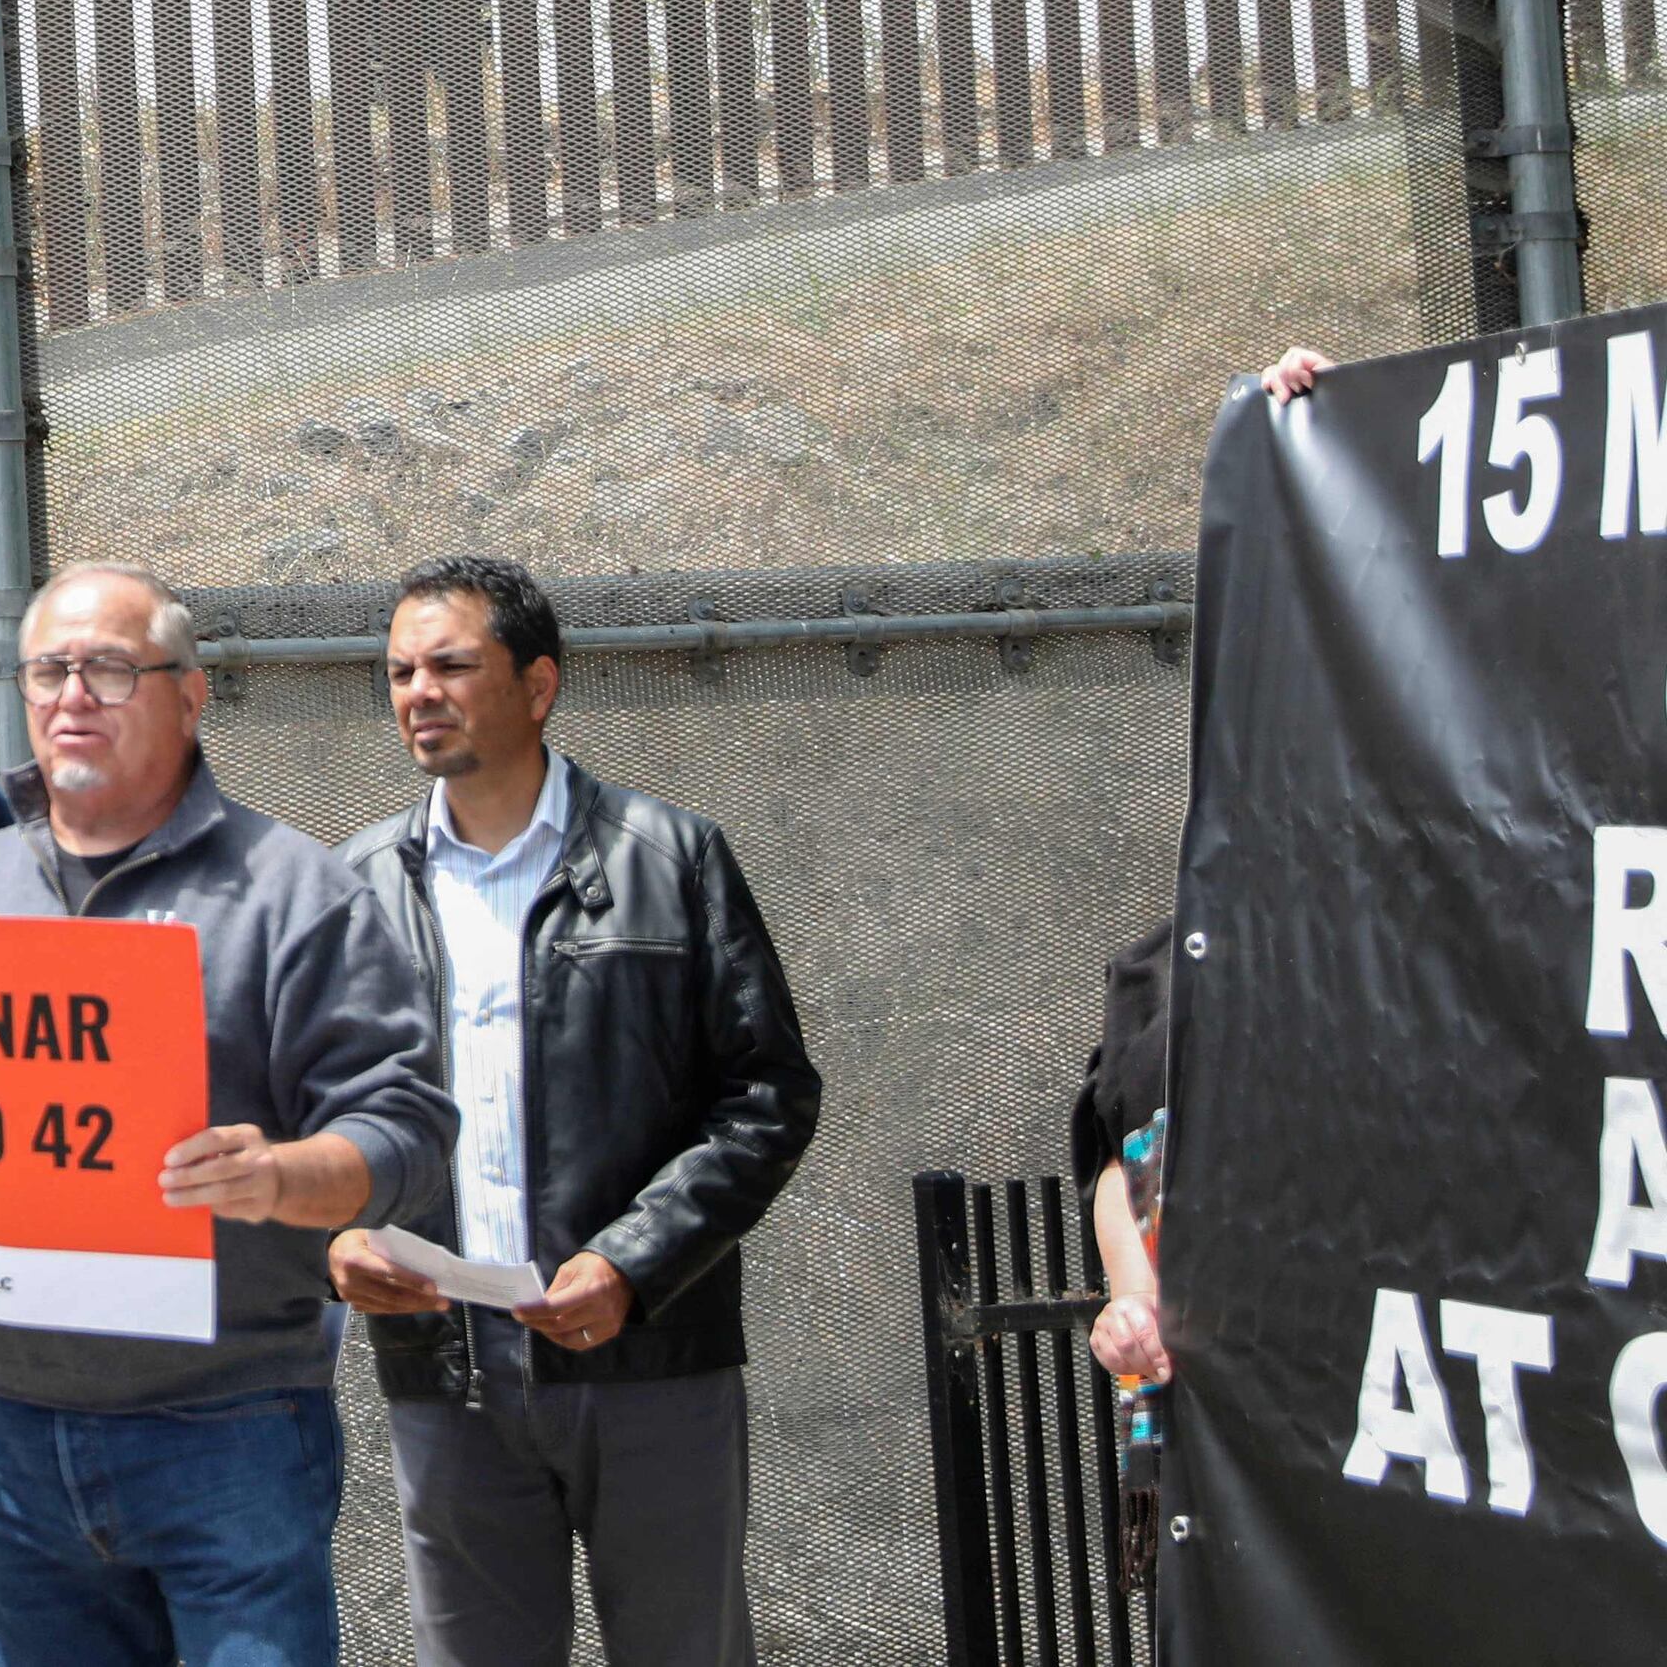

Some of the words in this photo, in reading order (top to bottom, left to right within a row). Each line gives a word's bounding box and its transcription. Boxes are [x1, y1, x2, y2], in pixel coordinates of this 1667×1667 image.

[1417, 347, 1562, 558] 15
[32, 1104, 114, 1171] 42
[1341, 1287, 1554, 1517] AT
